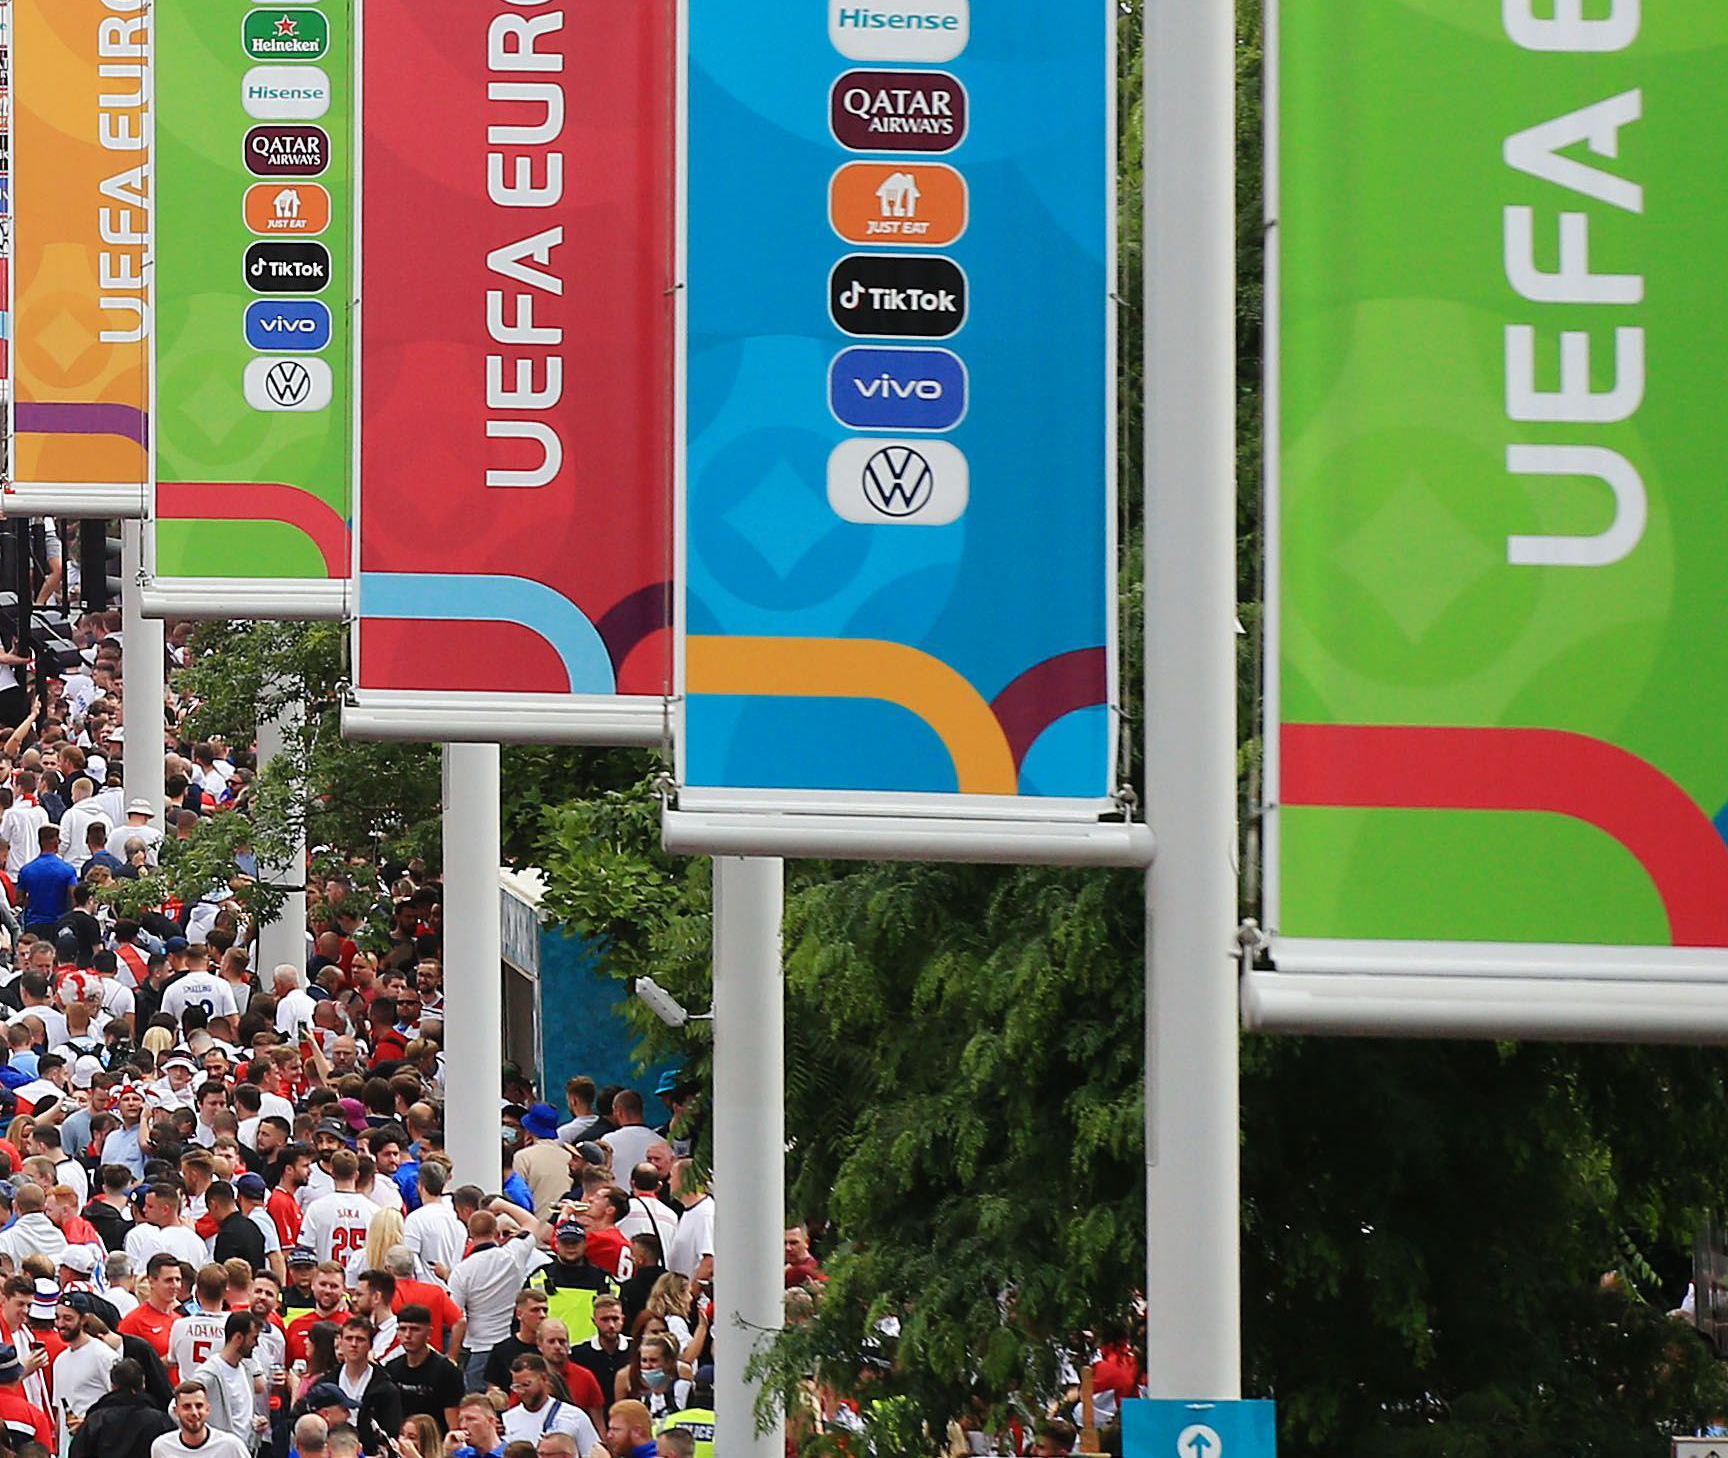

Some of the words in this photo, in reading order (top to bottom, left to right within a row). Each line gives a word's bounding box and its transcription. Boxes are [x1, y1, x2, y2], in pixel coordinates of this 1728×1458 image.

[839, 8, 958, 31] Hisense
[252, 38, 318, 52] Heineken
[248, 86, 324, 100] Hisense
[844, 88, 952, 117] QATAR
[870, 114, 953, 135] AIRWAYS
[252, 136, 320, 155] QATAR
[268, 153, 321, 165] AIRWAYS
[267, 220, 287, 229] JUST
[289, 219, 307, 229] EAT
[866, 220, 899, 234] JUST
[901, 220, 929, 234] EAT
[99, 159, 151, 344] UEFA
[269, 261, 323, 276] TikTok
[869, 289, 956, 313] TikTok
[260, 315, 316, 333] vivo
[1502, 87, 1648, 568] UEFA
[485, 226, 564, 488] UEFA
[854, 374, 942, 400] vivo
[332, 1226, 368, 1270] 25
[617, 1245, 633, 1280] 6
[186, 1323, 224, 1337] ADAMS
[193, 1341, 213, 1364] 5
